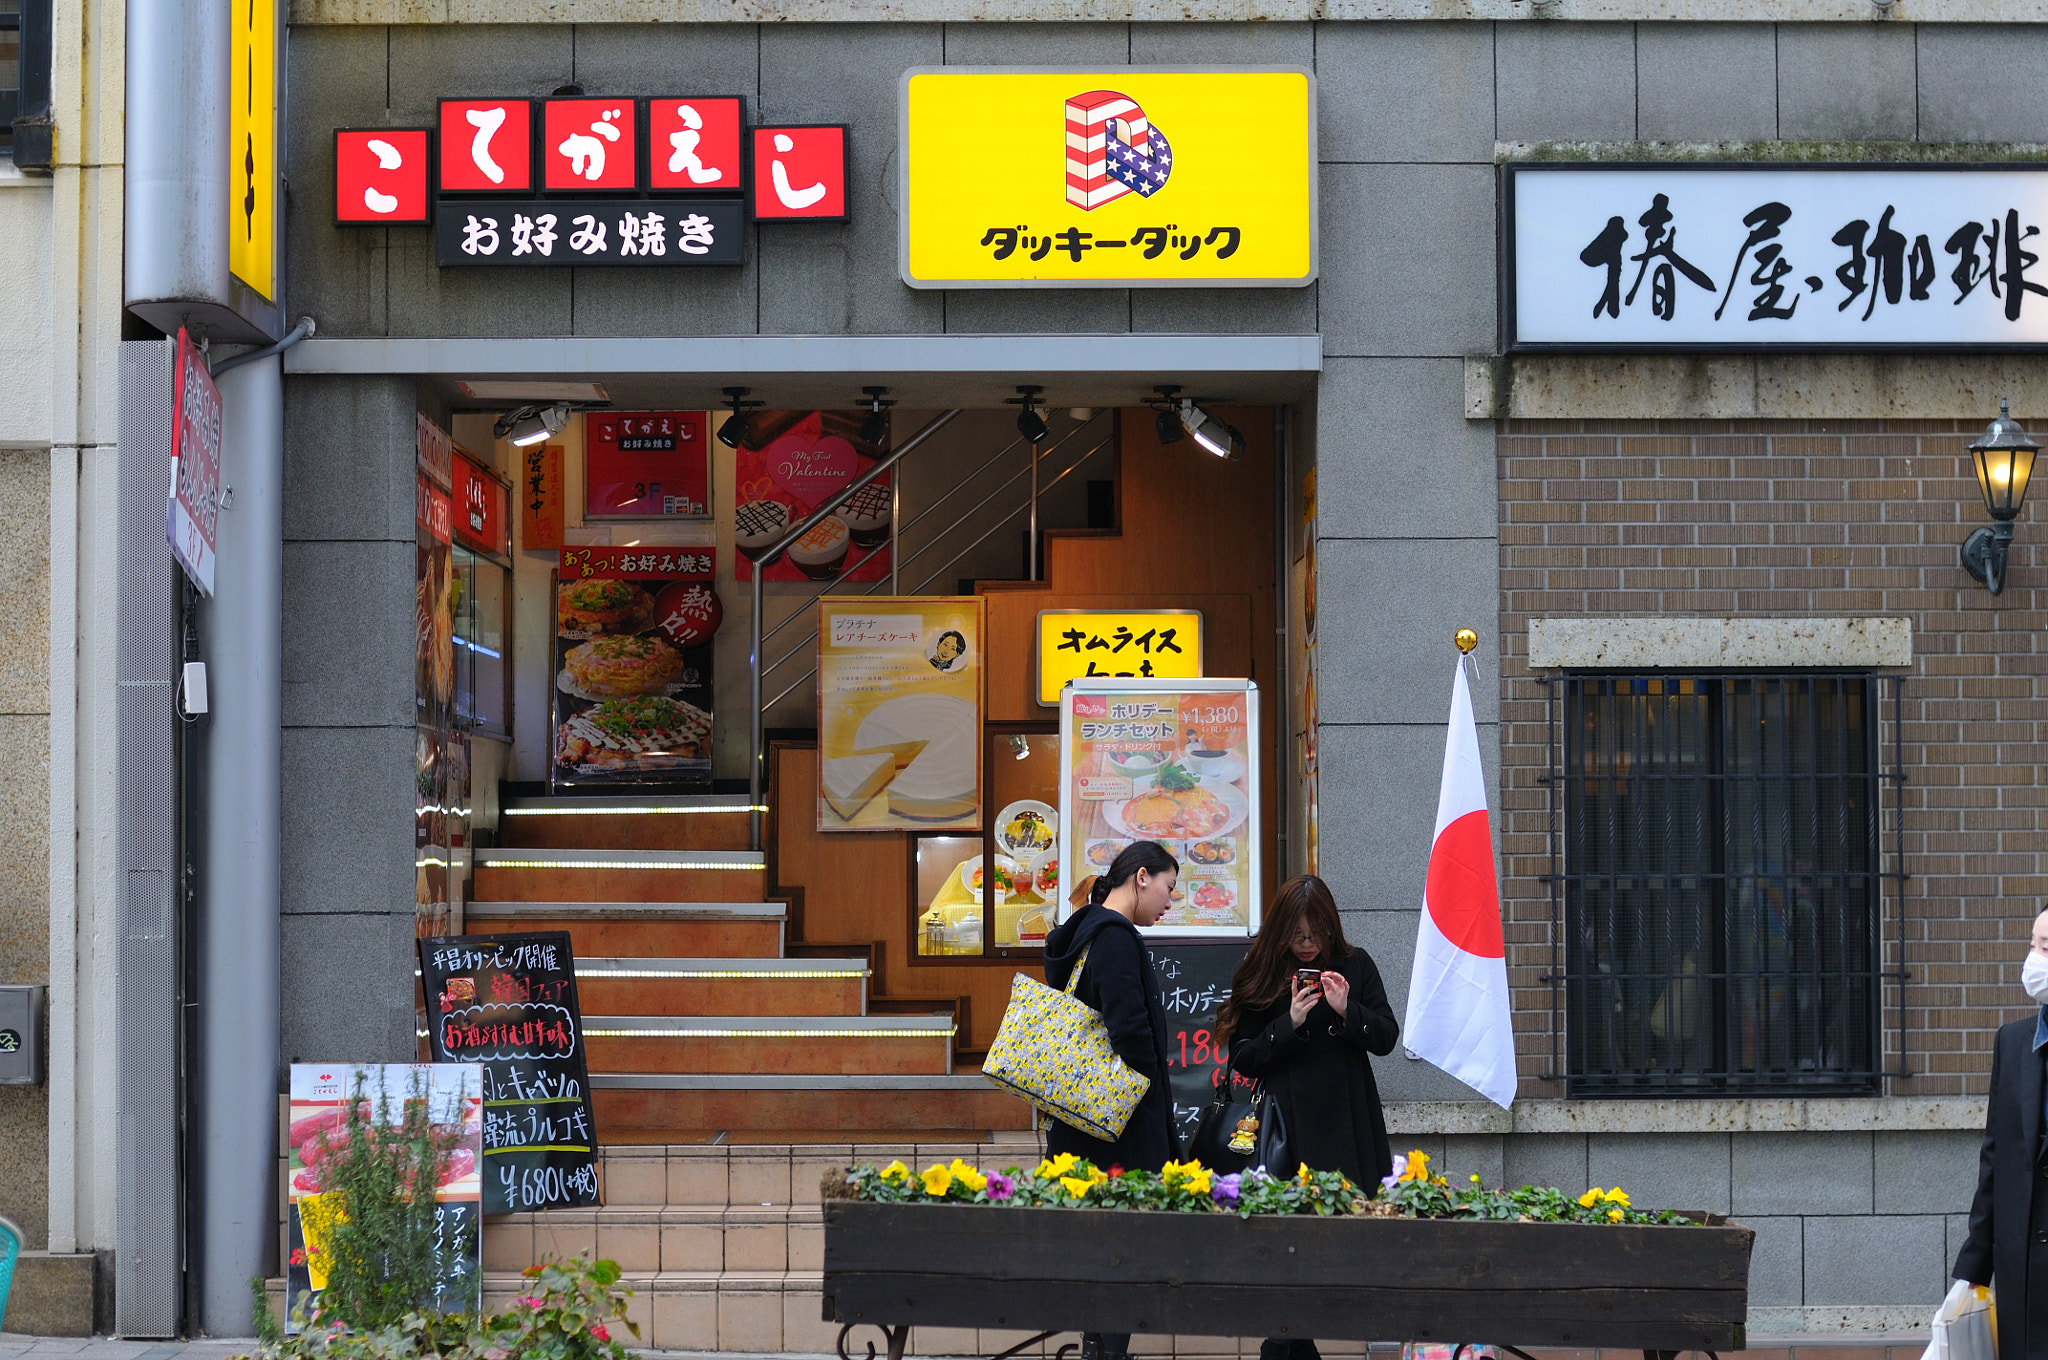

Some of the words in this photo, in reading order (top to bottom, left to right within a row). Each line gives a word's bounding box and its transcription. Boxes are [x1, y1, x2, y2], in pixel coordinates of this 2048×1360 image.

[364, 105, 826, 213] こてがえし
[462, 214, 715, 256] お好み焼き
[981, 225, 1240, 262] ダッキーダック
[604, 419, 692, 440] こてがえし
[622, 439, 672, 449] お好み焼き
[792, 451, 811, 462] My
[812, 451, 831, 460] First
[778, 461, 847, 480] Valentine
[528, 450, 545, 518] 営業中
[634, 482, 661, 499] 3F
[620, 553, 713, 574] お好み焼き
[836, 619, 876, 630] プラチナ
[836, 632, 918, 643] レアチーズケーキ
[1056, 626, 1182, 654] オムライス
[1111, 703, 1174, 719] ホリデー
[1182, 707, 1239, 725] ¥1,380
[1081, 722, 1174, 739] ランチセット
[432, 944, 561, 972] 平昌オリンピック開催
[491, 973, 569, 1004] 韓国フェア
[445, 1019, 569, 1049] お酒がすすむ甘辛味
[450, 1206, 467, 1280] アンガス牛
